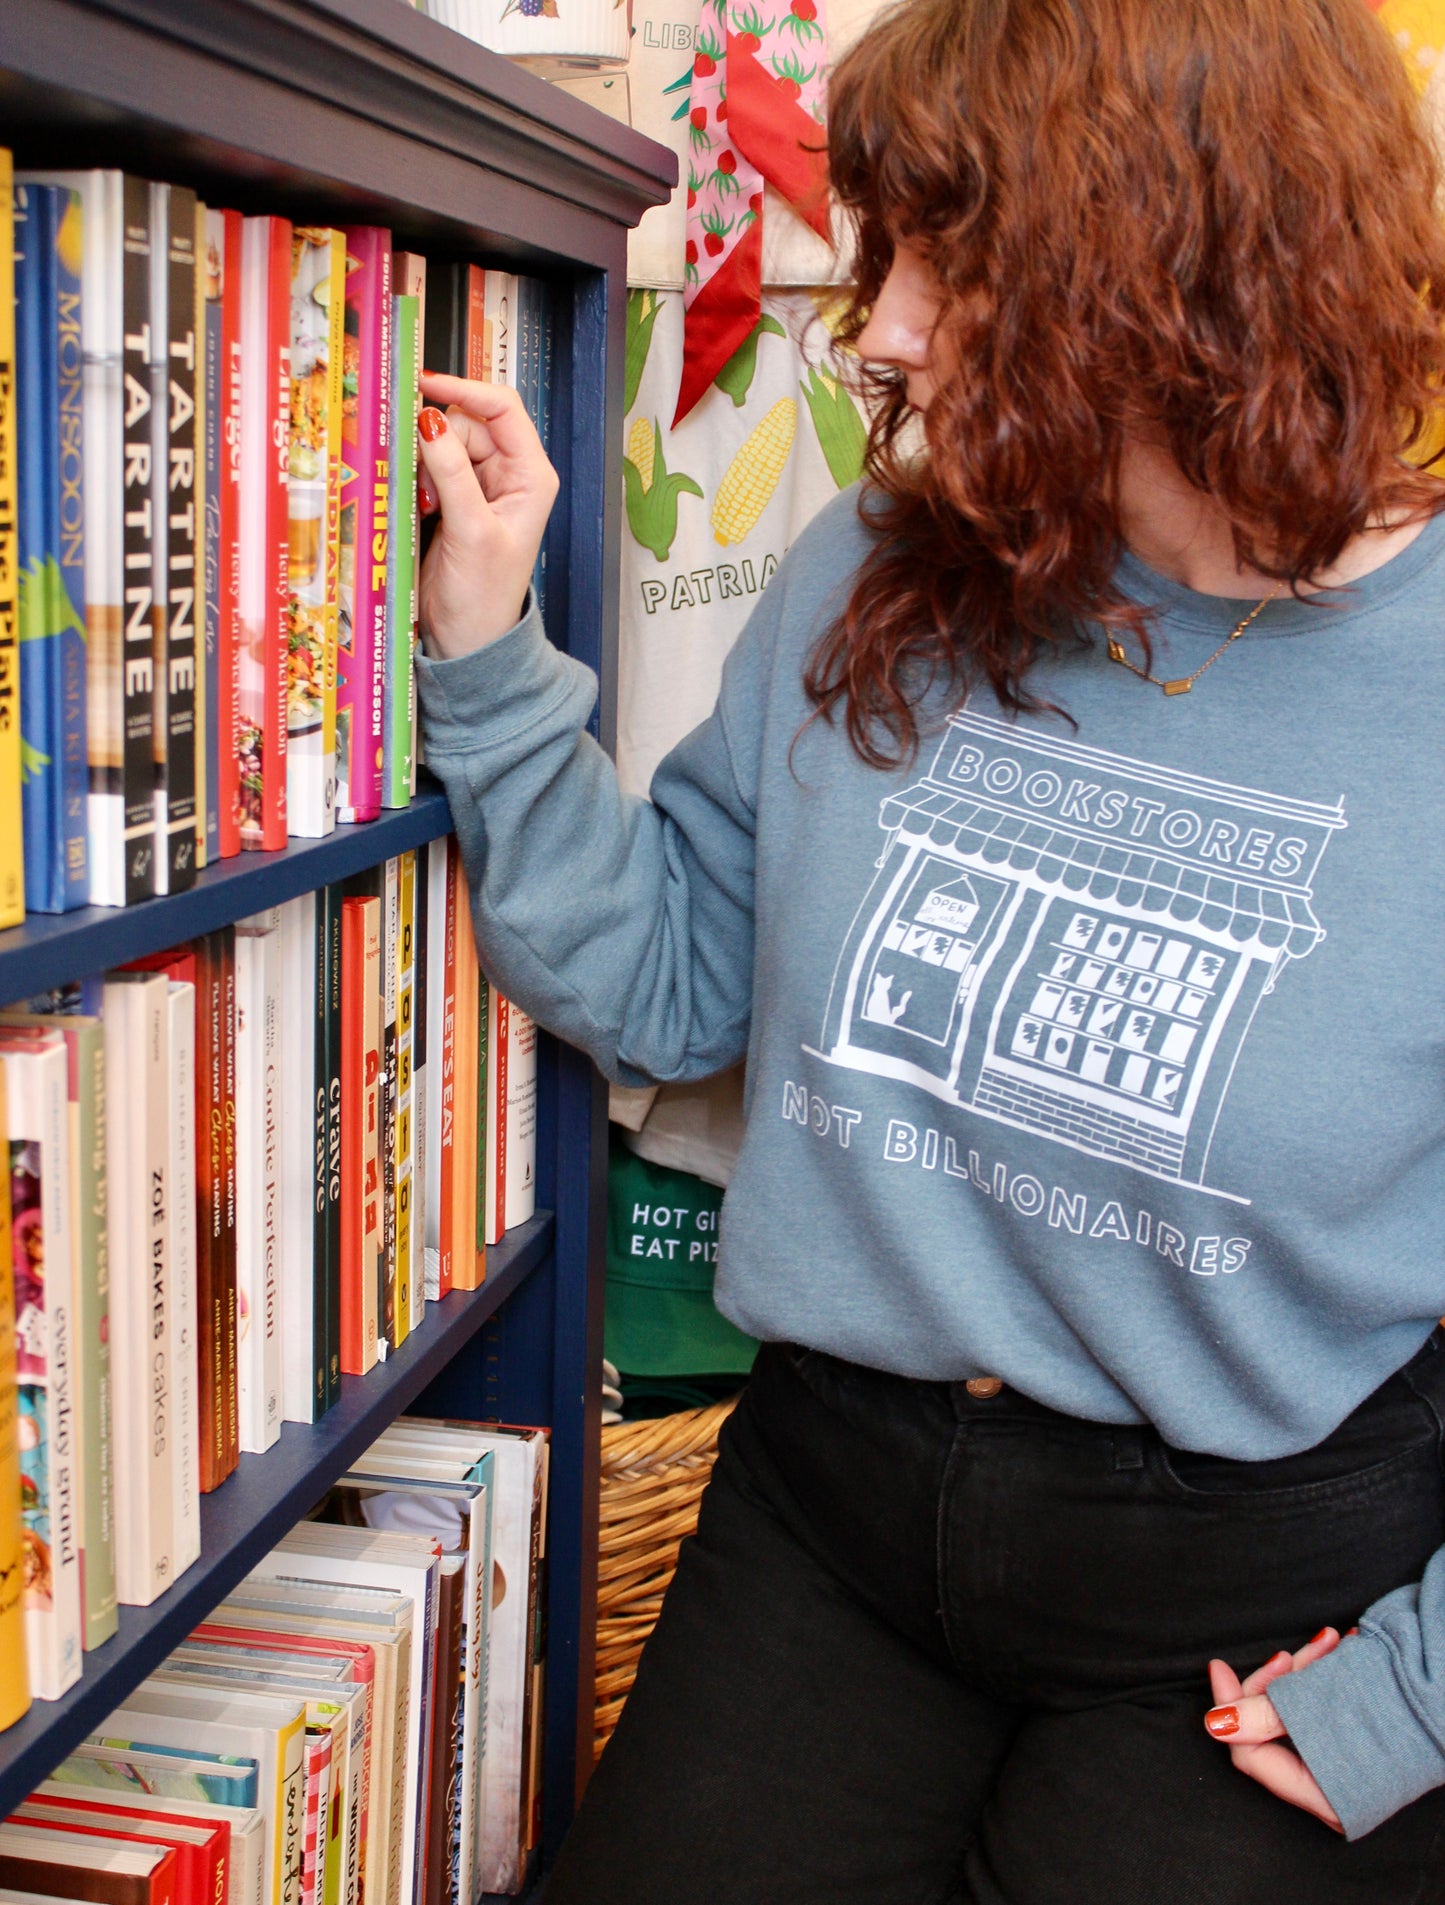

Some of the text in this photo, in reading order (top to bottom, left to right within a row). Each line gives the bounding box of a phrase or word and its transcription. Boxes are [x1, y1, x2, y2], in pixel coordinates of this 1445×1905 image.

[382, 252, 390, 296] SOUL
[379, 314, 388, 400] AMERICAN
[521, 310, 529, 388] SIMPLY
[58, 294, 84, 567] MONSOON
[273, 345, 291, 489] Linger
[378, 403, 387, 447] FOOD
[124, 324, 153, 698] TARTINE
[168, 331, 196, 695] TARTINE
[327, 454, 338, 603] INDIAN
[371, 482, 389, 592] RISE
[641, 548, 787, 614] PATRIA
[372, 604, 383, 737] SAMUELSSON
[948, 744, 1308, 877] BOOKSTORES
[931, 896, 968, 913] OPEN
[212, 1011, 220, 1056] HAVE
[226, 1003, 234, 1047] HAVE
[443, 993, 455, 1078] LET'S
[212, 1058, 220, 1104] WHAT
[226, 1048, 234, 1096] WHAT
[388, 1038, 397, 1100] THE
[210, 1108, 222, 1175] Cheese
[225, 1099, 236, 1165] Cheese
[315, 1086, 327, 1213] crave
[328, 1077, 341, 1202] crave
[388, 1112, 396, 1165] JOY
[442, 1086, 454, 1148] EAT
[152, 1168, 166, 1227] ZOË
[212, 1177, 220, 1238] HAVING
[226, 1168, 235, 1228] HAVING
[265, 1064, 277, 1340] Cookie Perfection
[632, 1203, 721, 1231] HOT GI
[781, 1080, 1253, 1276] NOT BILLIONAIRES
[387, 1193, 396, 1285] PIZZA
[631, 1234, 680, 1260] EAT
[152, 1238, 165, 1340] BAKES
[214, 1298, 223, 1383] ANNE-MARIE
[227, 1287, 236, 1371] ANNE-MARIE
[56, 1306, 76, 1568] everyday grand
[152, 1351, 168, 1458] cakes
[214, 1385, 223, 1459] PIETERSMA
[227, 1373, 236, 1447] PIETERSMA
[530, 1520, 543, 1583] share
[361, 1680, 375, 1814] NICOLE RUCKER
[316, 1792, 328, 1860] ITALIAN
[347, 1798, 359, 1878] WORLD
